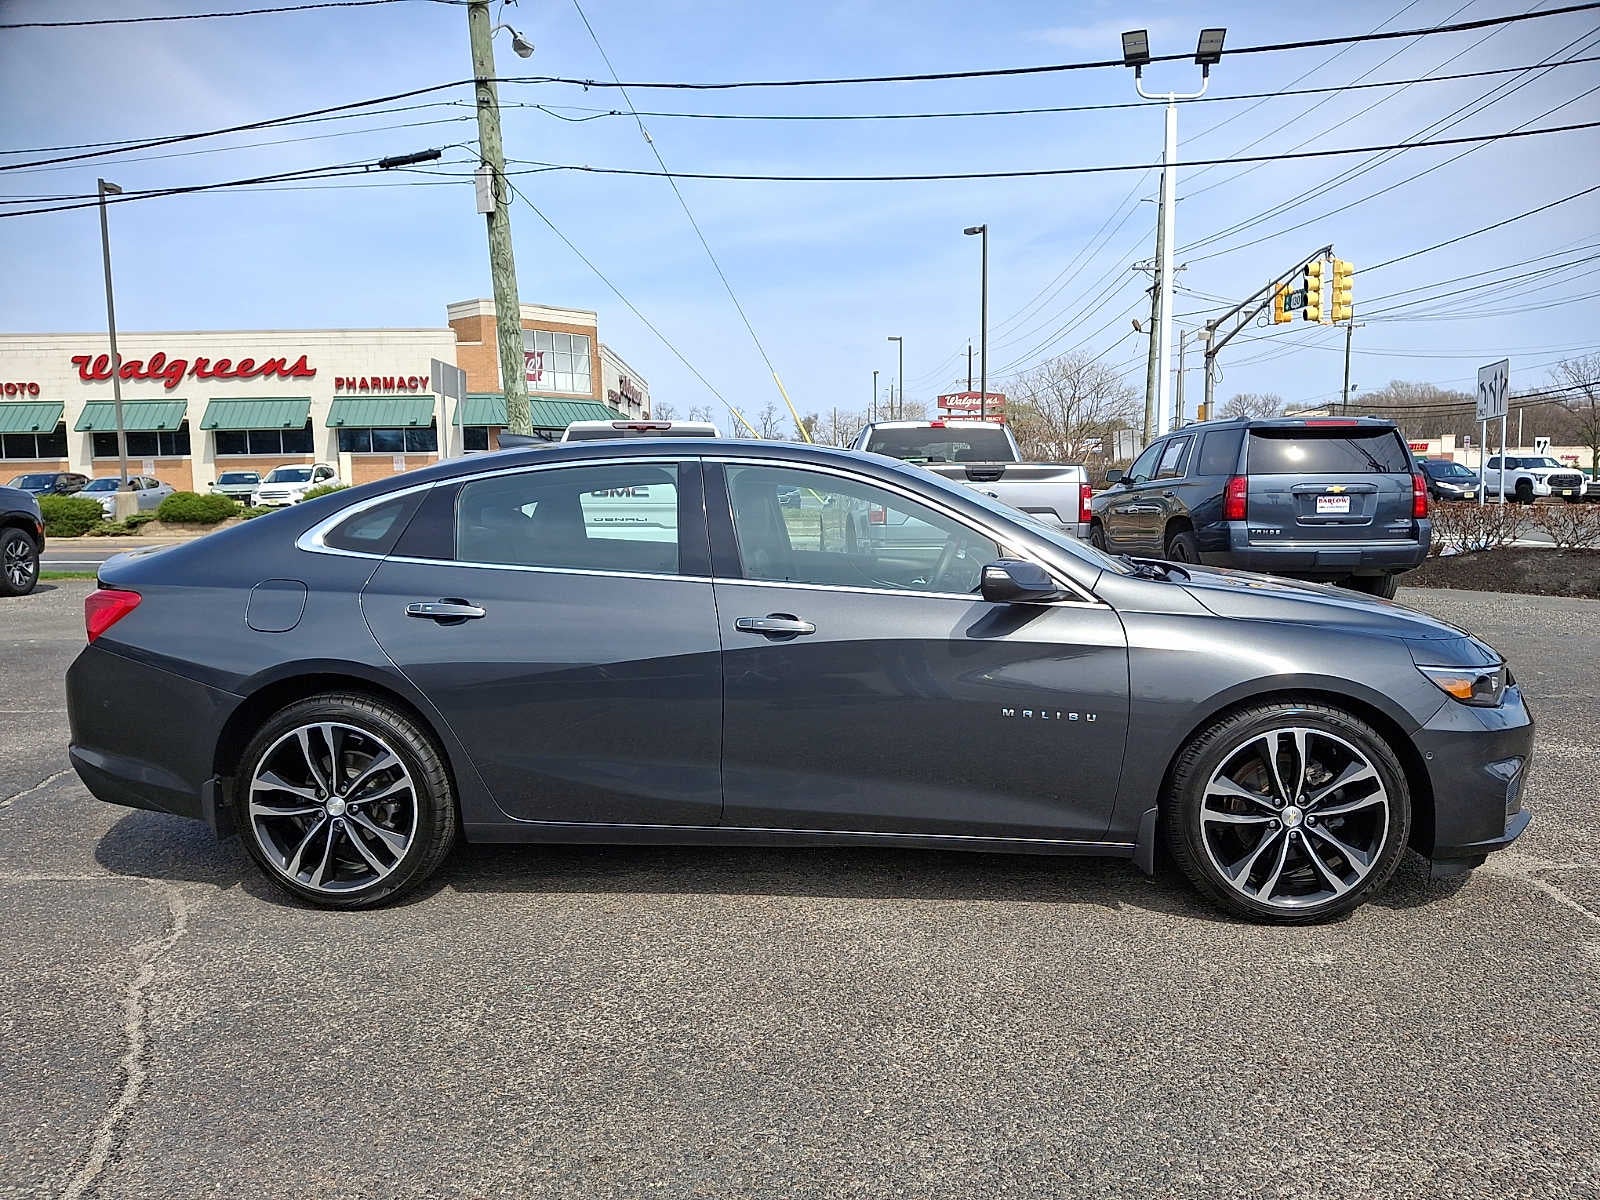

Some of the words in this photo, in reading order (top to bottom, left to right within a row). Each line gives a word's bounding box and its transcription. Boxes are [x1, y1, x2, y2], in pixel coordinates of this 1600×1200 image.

[71, 352, 316, 389] Walgreens
[0, 382, 40, 396] OTO
[335, 376, 429, 390] PHARMACY
[945, 395, 999, 408] Walgrens
[591, 487, 649, 497] GMC
[1002, 708, 1096, 722] MALIBU
